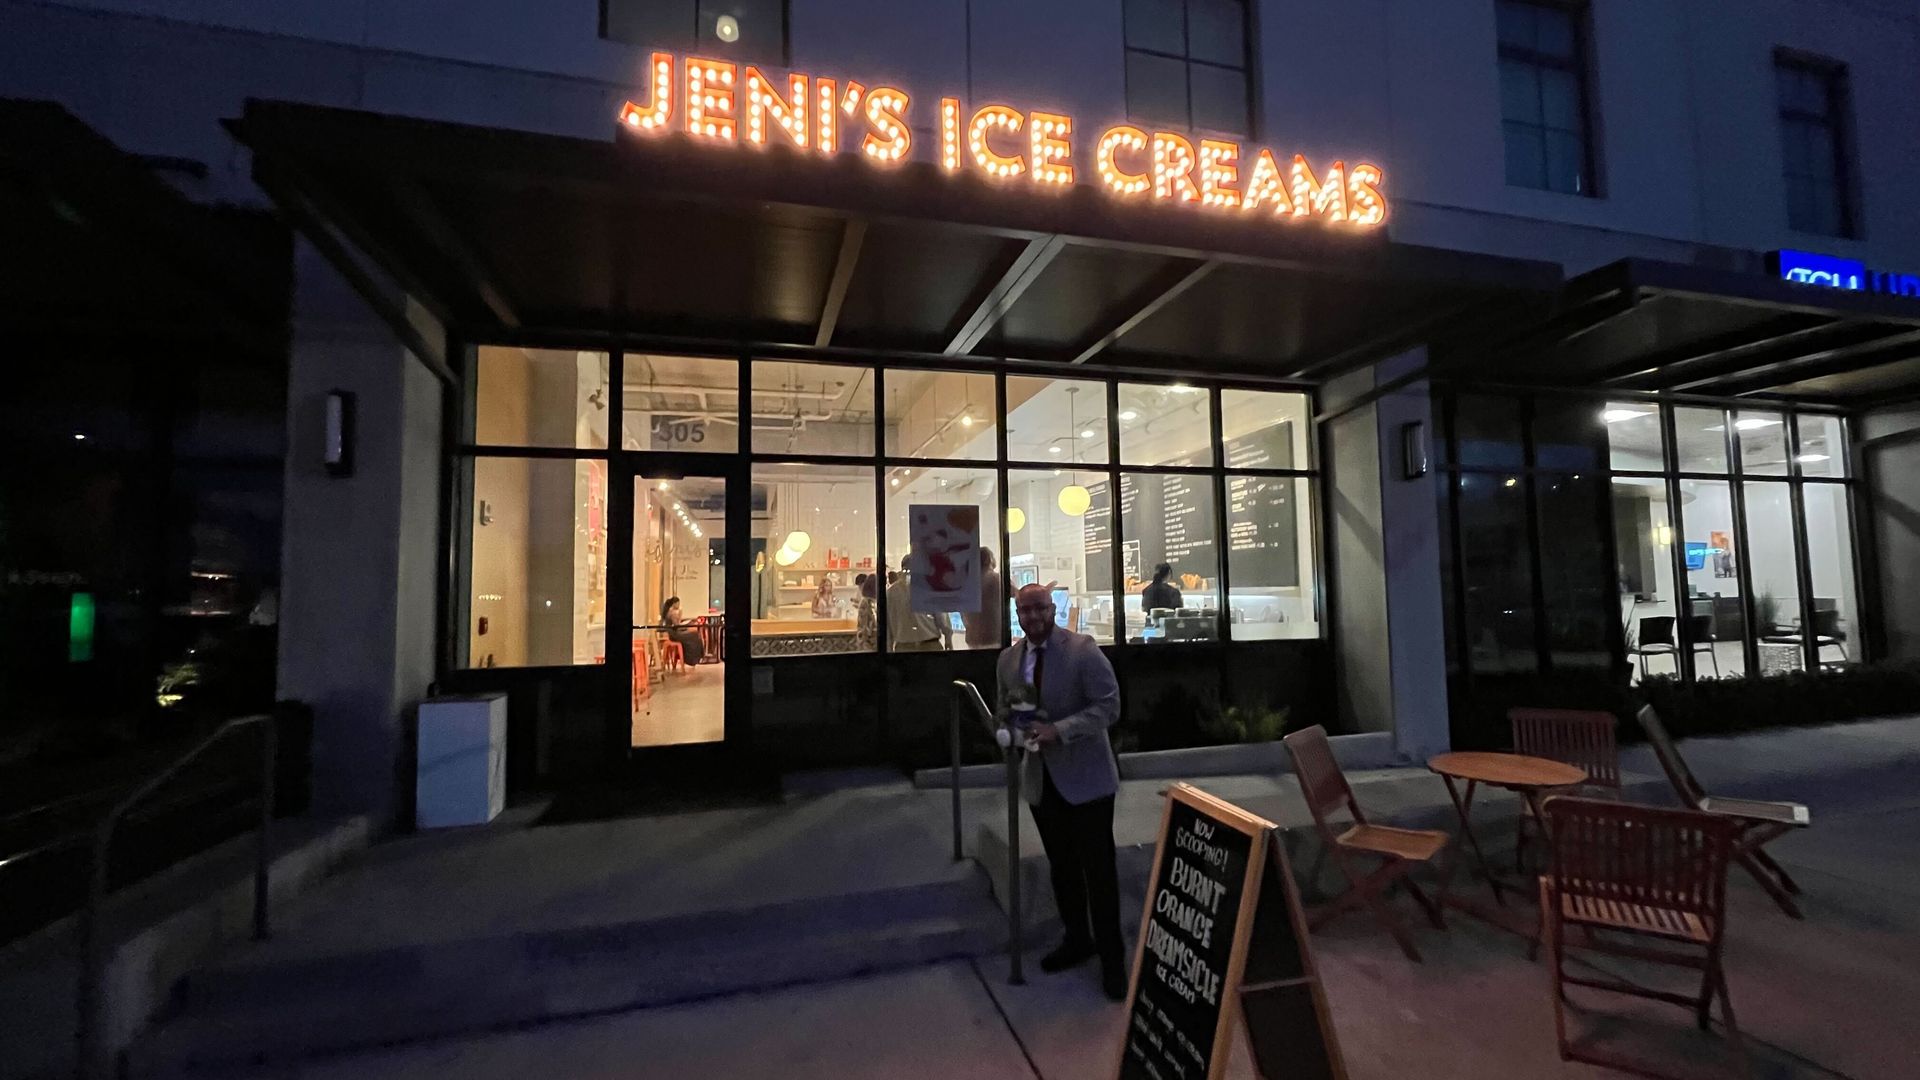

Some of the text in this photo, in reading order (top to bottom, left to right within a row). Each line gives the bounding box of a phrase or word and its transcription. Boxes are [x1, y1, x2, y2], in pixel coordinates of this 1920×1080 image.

[620, 53, 1386, 225] JENI'S ICE CREAMS
[1176, 826, 1229, 872] SCOOPING!
[1194, 818, 1215, 839] NOW
[1170, 857, 1226, 914] BURNT
[1156, 889, 1213, 949] ORANGE
[1146, 918, 1219, 1006] DREAMSICLE
[1156, 963, 1195, 1004] ICE CREAM
